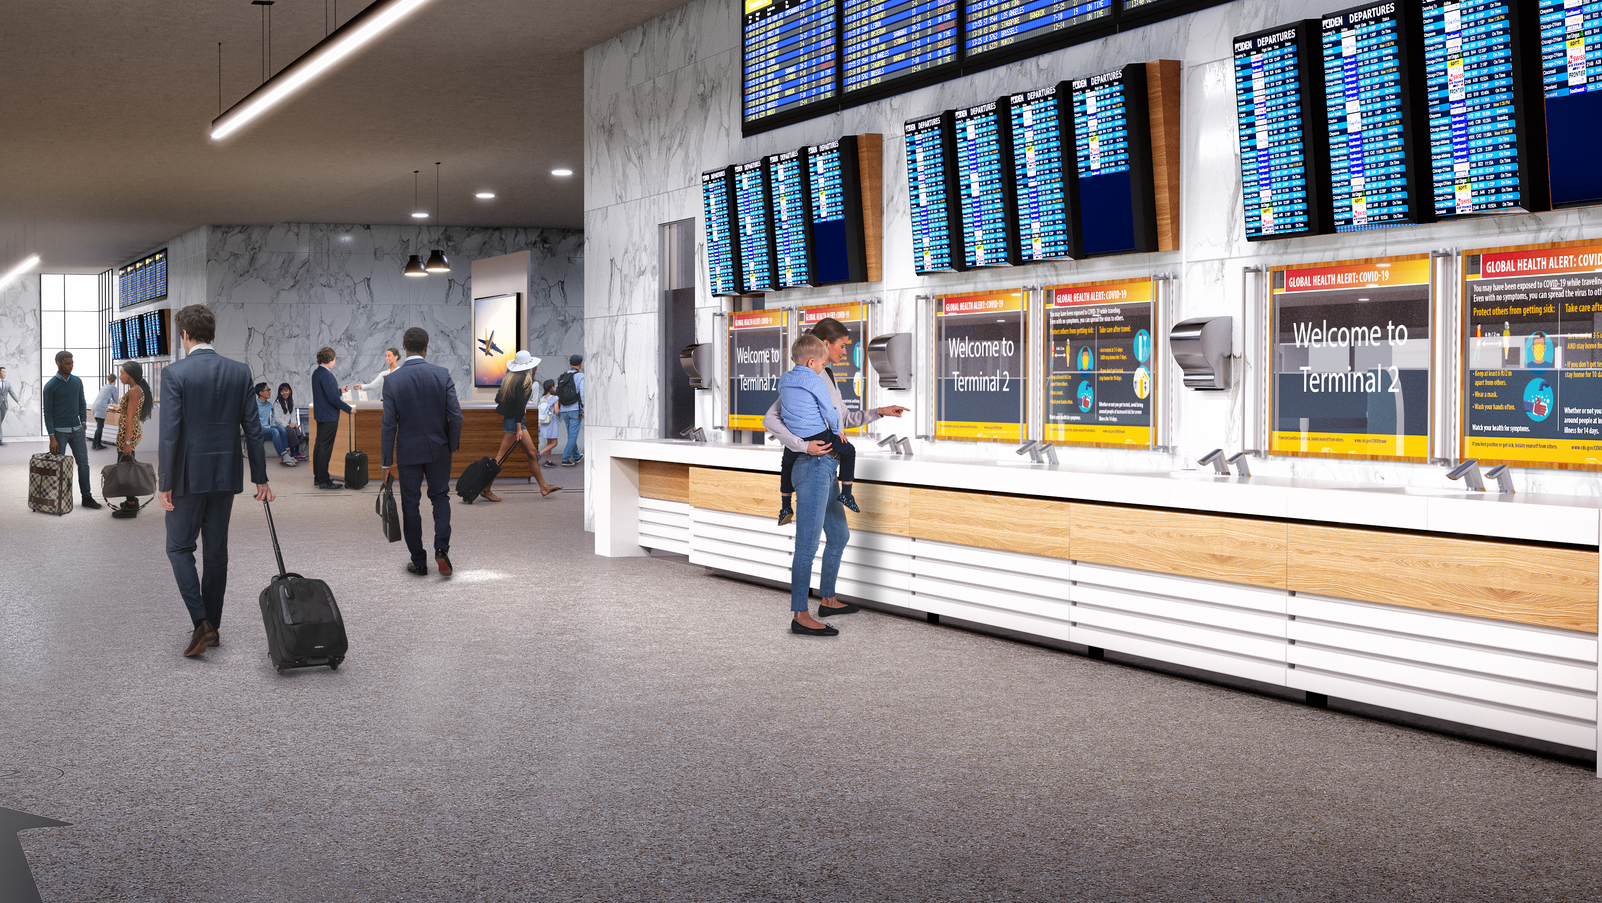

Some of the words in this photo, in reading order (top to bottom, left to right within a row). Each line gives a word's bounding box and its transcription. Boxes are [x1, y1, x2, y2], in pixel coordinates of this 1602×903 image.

[1349, 3, 1395, 23] DEPARTURES
[1257, 29, 1295, 47] DEPARTURES
[1090, 70, 1122, 86] DEPARTURES
[1027, 86, 1056, 100] DEPARTURES
[970, 102, 996, 115] DEPARTURES
[918, 117, 940, 128] DEPARTURES
[1486, 260, 1515, 273] GLOBAL
[1517, 257, 1547, 271] HEALTH
[1549, 255, 1576, 269] ALERT:
[1289, 276, 1311, 287] GLOBAL
[1313, 274, 1336, 286] HEALTH
[1337, 273, 1358, 284] ALERT:
[1359, 270, 1389, 282] COVID-19
[1517, 281, 1536, 291] exposed
[1544, 279, 1566, 288] COVID-19
[1567, 278, 1581, 286] while
[1582, 277, 1602, 287] travelin
[1057, 294, 1073, 303] GLOBAL
[1074, 292, 1089, 302] HEALTH
[1090, 291, 1105, 300] ALERT:
[1106, 290, 1127, 299] COVID-19
[1503, 293, 1528, 302] symptoms,
[1548, 289, 1564, 299] spread
[946, 303, 959, 311] GLOBAL
[960, 302, 973, 310] HEALTH
[974, 301, 986, 309] ALERT:
[987, 299, 1003, 309] COVID-19
[1473, 308, 1491, 316] Protect
[1492, 307, 1508, 315] others
[1510, 306, 1521, 314] from
[1523, 305, 1542, 316] getting
[1543, 304, 1555, 313] sick:
[1565, 303, 1577, 312] Take
[1293, 320, 1382, 348] Welcome
[1387, 320, 1408, 346] to
[948, 336, 1000, 357] Welcome
[1003, 338, 1014, 356] to
[737, 346, 769, 363] Welcome
[772, 349, 779, 363] to
[739, 373, 770, 390] Terminal
[772, 376, 776, 390] 2
[952, 370, 1000, 392] Terminal
[1003, 372, 1009, 391] 2
[1300, 364, 1381, 392] Terminal
[1388, 366, 1400, 392] 2
[1579, 417, 1592, 425] people
[1589, 427, 1599, 435] days.
